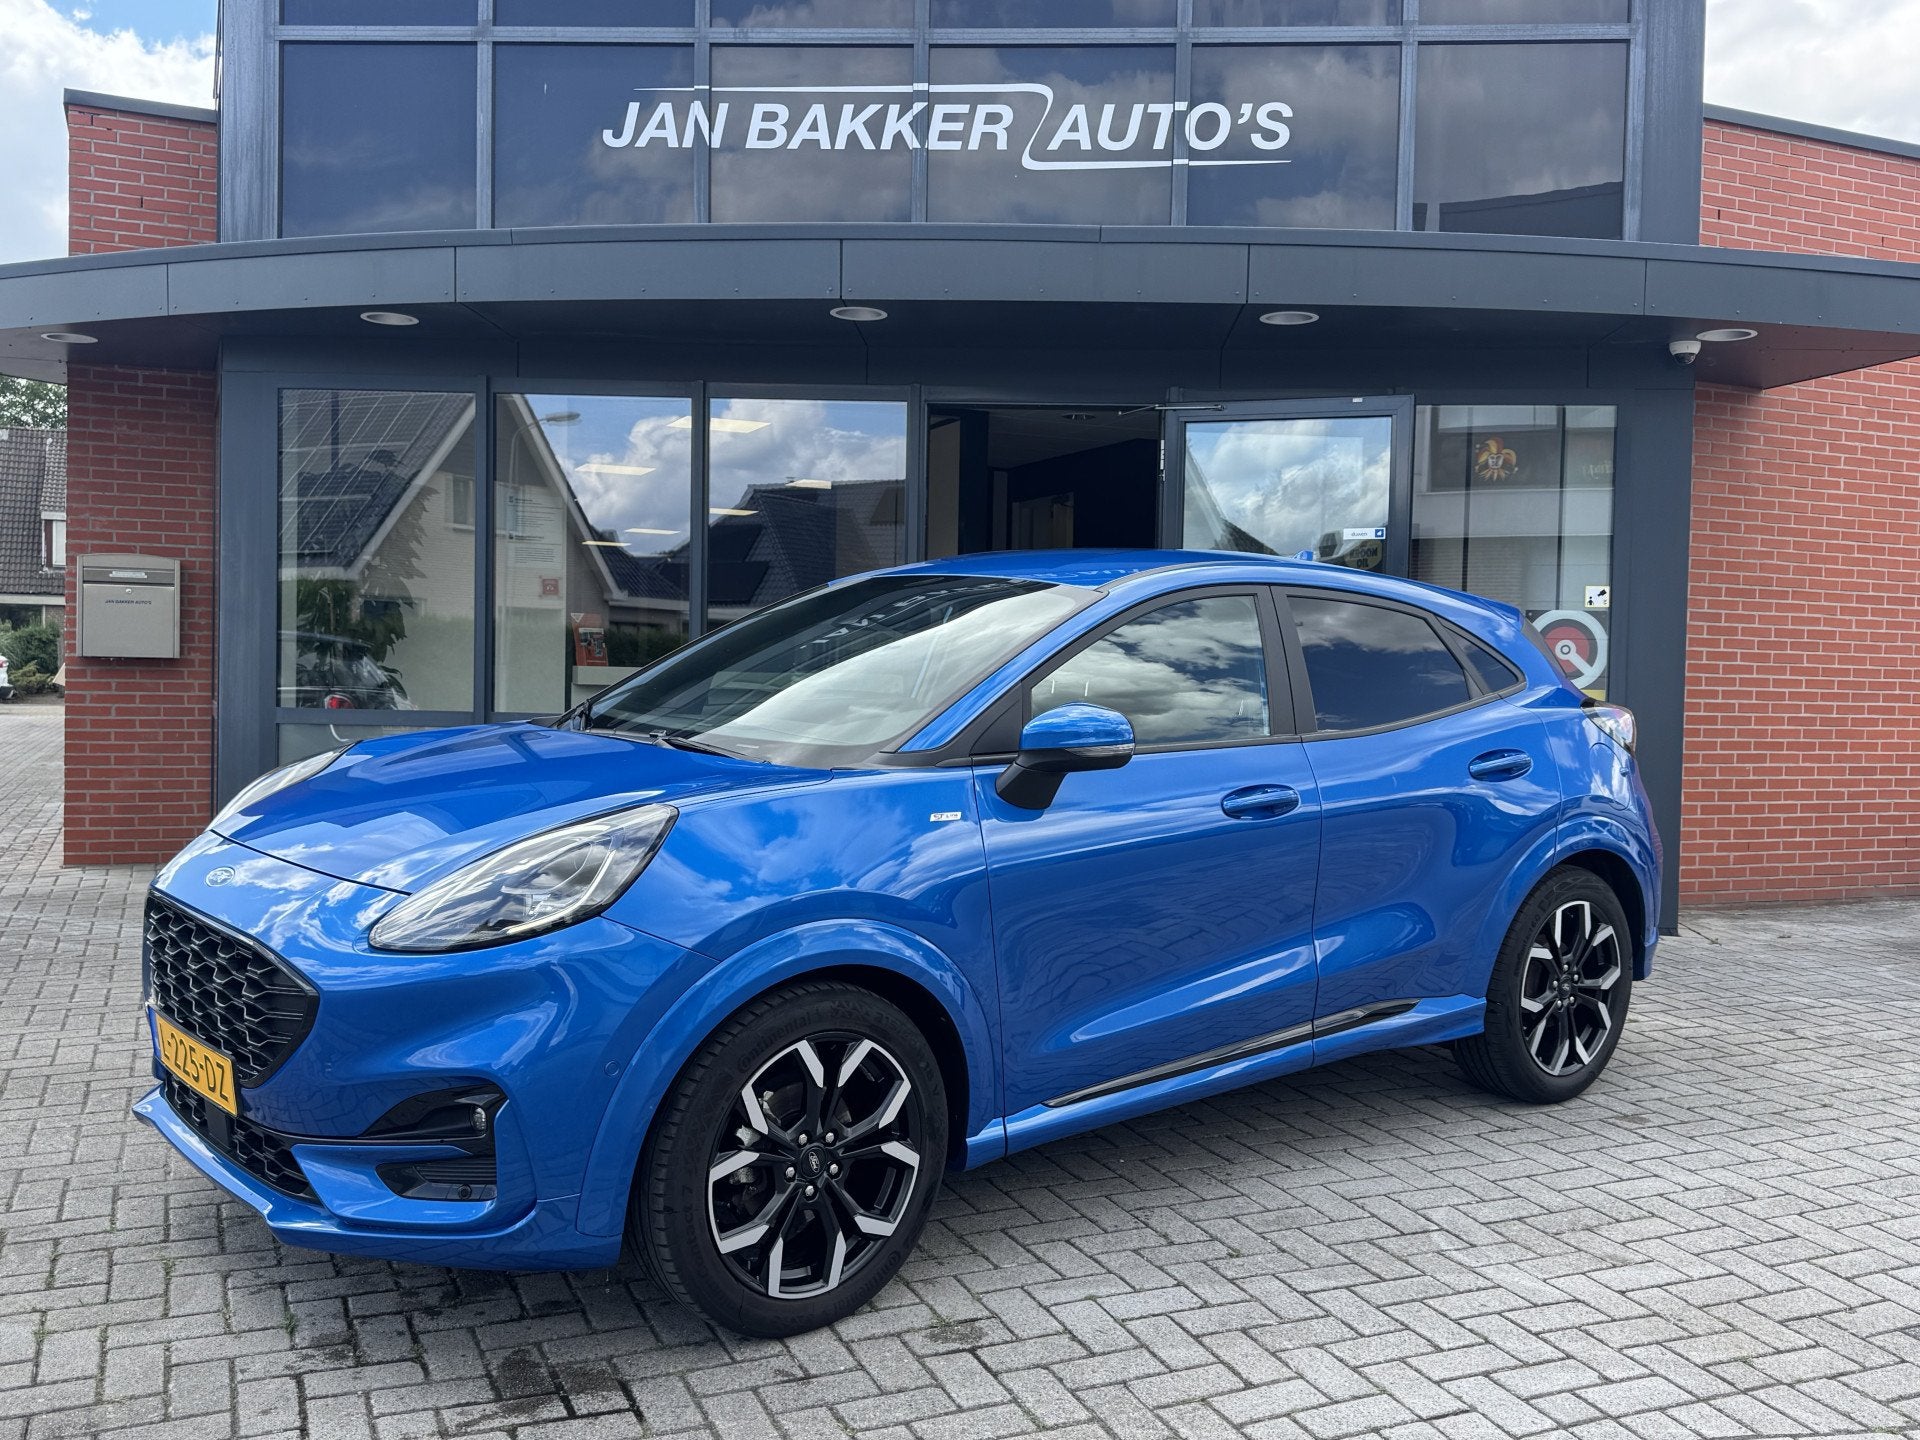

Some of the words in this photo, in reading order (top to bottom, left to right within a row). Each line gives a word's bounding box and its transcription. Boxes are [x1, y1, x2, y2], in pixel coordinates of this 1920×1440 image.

[602, 101, 730, 149] JAN
[745, 102, 1013, 151] BAKKER
[1046, 102, 1294, 151] AUTO'S
[159, 1021, 230, 1103] L-225-DZ
